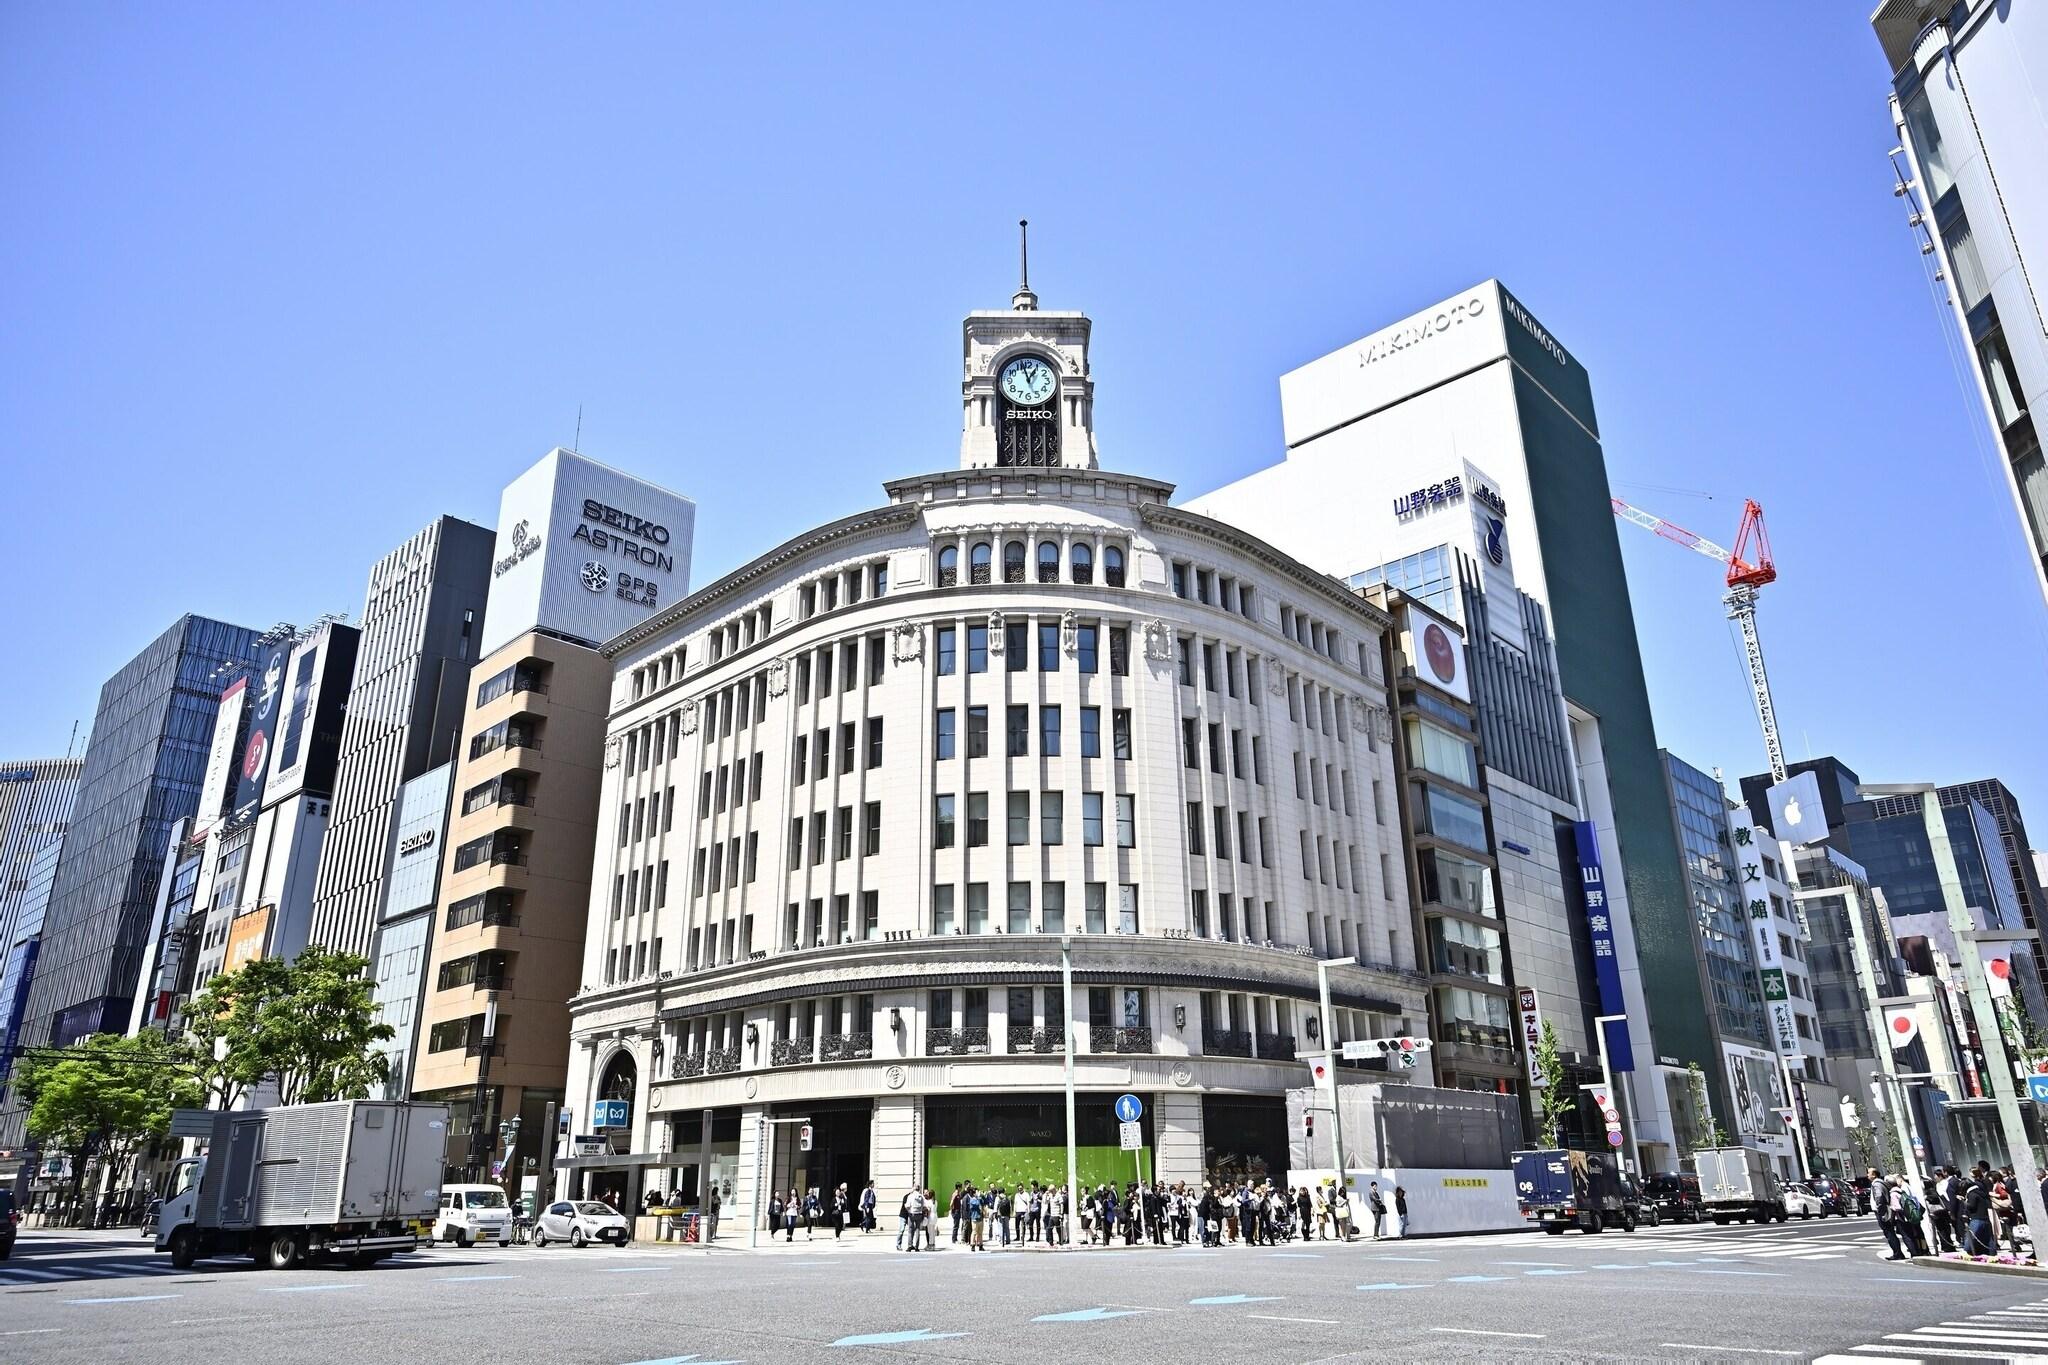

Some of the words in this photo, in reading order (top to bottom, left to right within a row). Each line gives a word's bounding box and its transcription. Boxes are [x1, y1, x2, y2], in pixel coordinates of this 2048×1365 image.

[1359, 299, 1485, 368] MIKIMOTO
[1505, 295, 1567, 366] MIKIMOTO
[1006, 410, 1052, 419] SEIKO
[1393, 476, 1462, 516] 山野楽器
[583, 499, 670, 545] SEIKO
[572, 523, 673, 573] ASTRON
[616, 587, 657, 608] SOLAR
[618, 572, 658, 597] GPS
[400, 827, 435, 856] SEIKO
[1734, 826, 1768, 919] 教文館
[1582, 866, 1612, 957] 山野楽器
[1763, 974, 1783, 996] 本
[1774, 1006, 1792, 1049] ナルニア国
